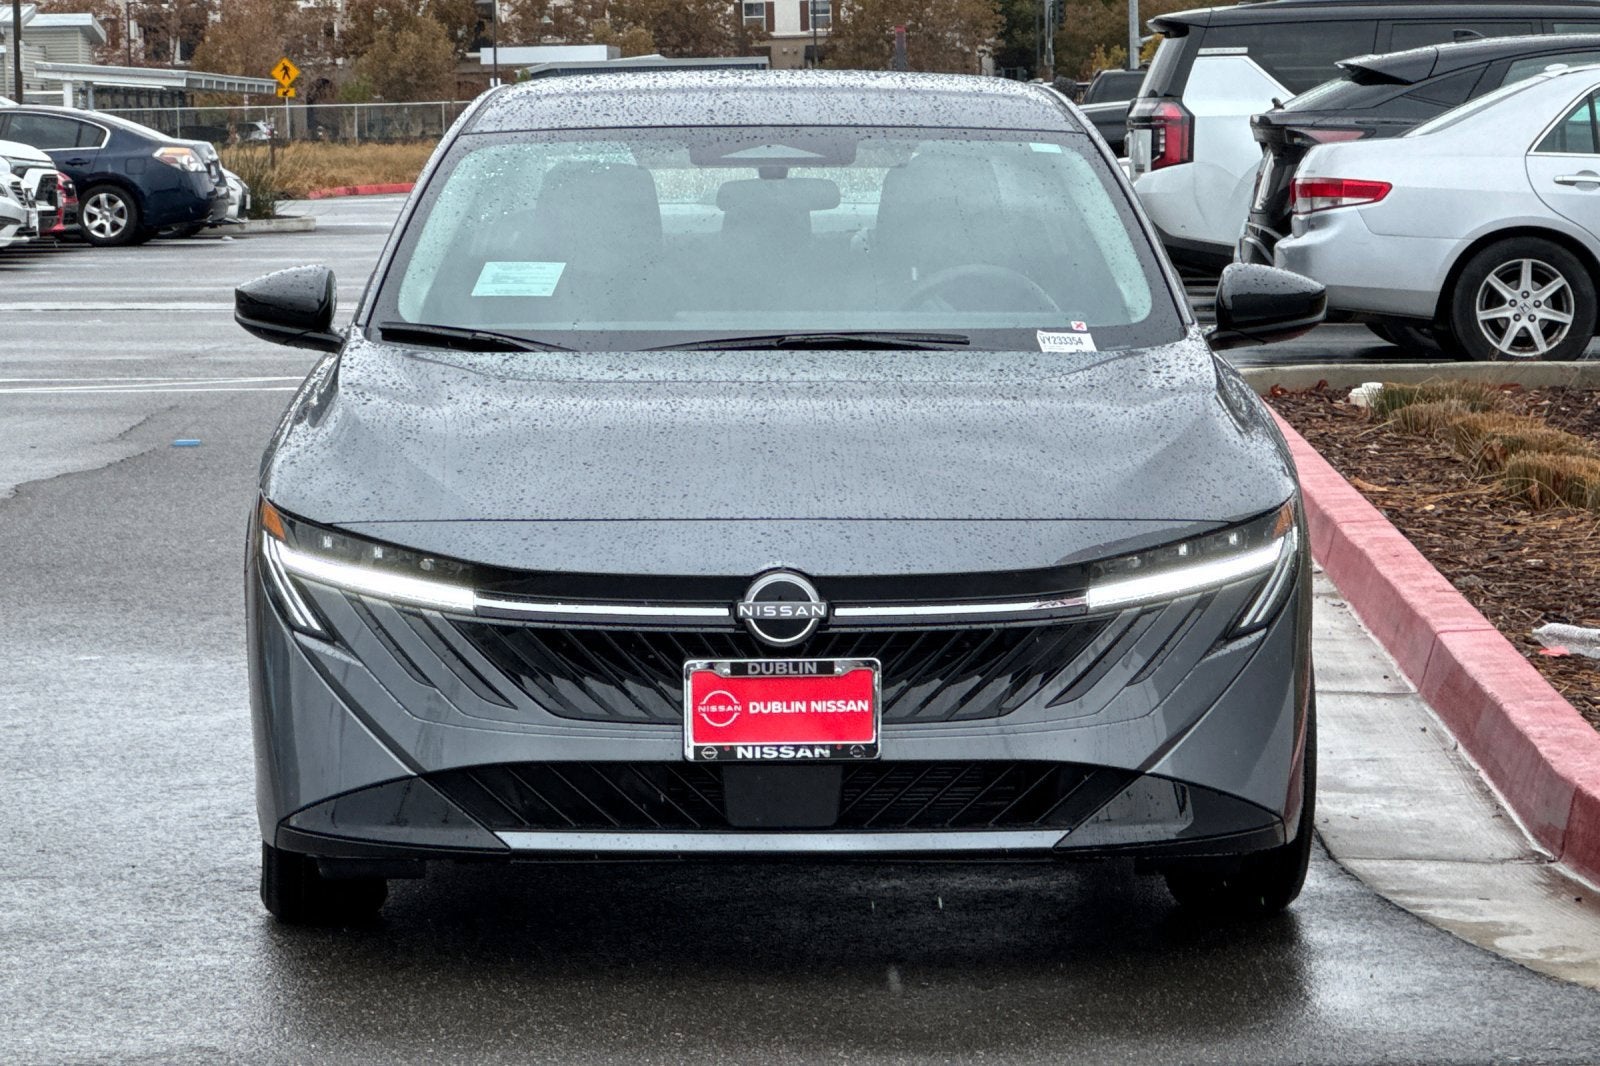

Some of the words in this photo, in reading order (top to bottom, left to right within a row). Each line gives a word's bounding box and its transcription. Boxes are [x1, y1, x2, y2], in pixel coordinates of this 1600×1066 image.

[739, 605, 825, 616] NISSAN
[748, 661, 817, 675] DUBLIN
[698, 705, 742, 713] NISSAN
[749, 701, 807, 714] DUBLIN
[810, 700, 869, 713] NISSAN
[736, 745, 831, 759] NISSAN
